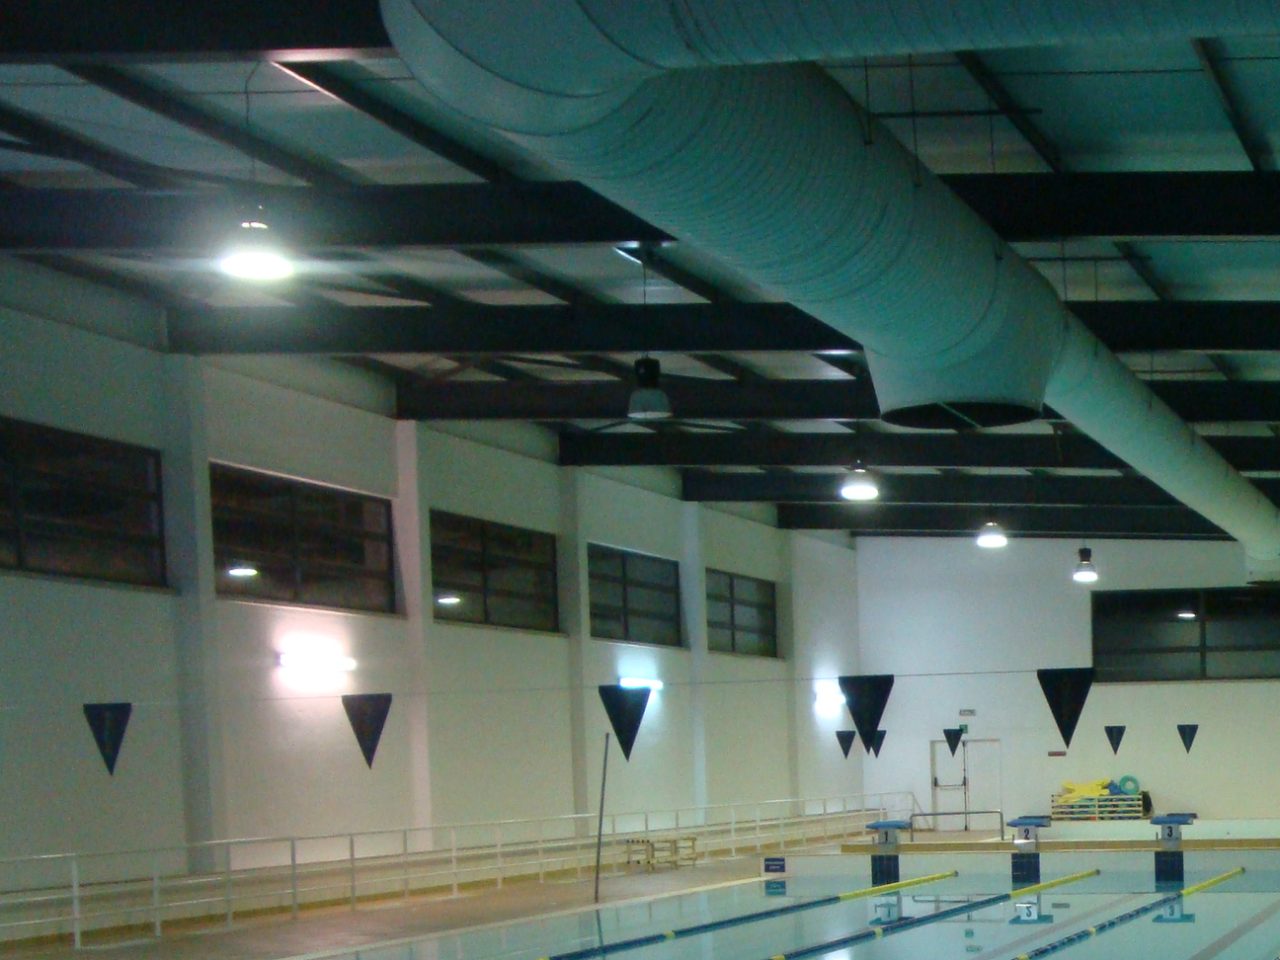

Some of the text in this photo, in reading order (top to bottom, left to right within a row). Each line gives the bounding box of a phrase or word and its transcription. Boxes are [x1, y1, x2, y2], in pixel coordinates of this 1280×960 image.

[884, 831, 889, 842] 1
[1024, 828, 1030, 840] 2
[1167, 826, 1173, 838] 3
